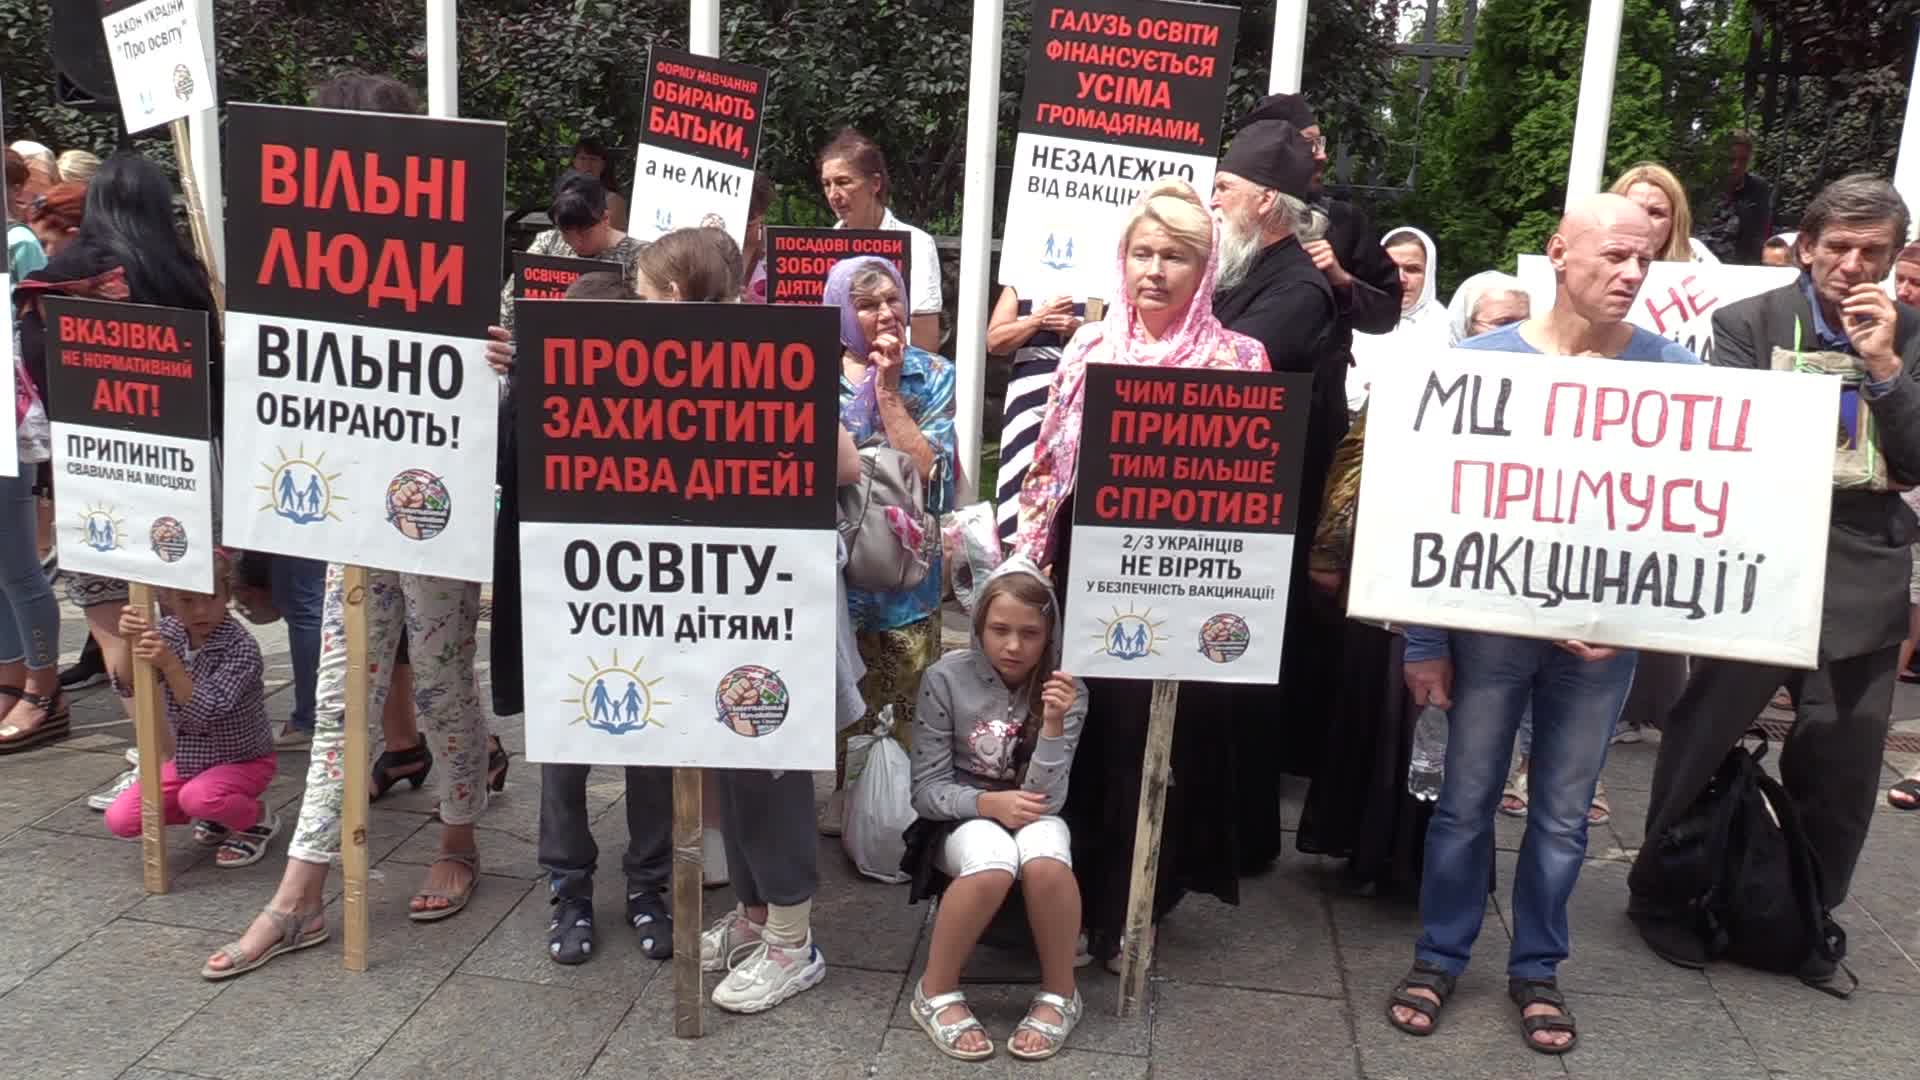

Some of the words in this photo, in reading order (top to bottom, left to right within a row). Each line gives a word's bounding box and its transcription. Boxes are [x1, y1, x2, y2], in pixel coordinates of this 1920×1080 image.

[1051, 8, 1131, 37] ГАЛУЗЬ
[1137, 19, 1219, 46] ОСВІТИ
[1046, 40, 1215, 77] ФІНАНСУЄТЬСЯ
[656, 62, 696, 80] ФОРМУ
[697, 71, 758, 94] НАВЧАННЯ
[1076, 72, 1173, 109] УСІМА
[653, 80, 755, 120] ОБИРАЮТЬ
[649, 106, 749, 159] БАТЬКИ,
[1036, 104, 1205, 145] ГРОМАДЯНАМИ,
[260, 143, 465, 222] ВІЛЬНІ
[646, 160, 657, 176] а
[663, 164, 686, 183] не
[691, 166, 741, 197] ЛКК!
[1031, 145, 1194, 182] НЕЗАЛЕЖНО
[1028, 176, 1059, 198] ВІД
[775, 237, 849, 253] ПОСАДОВІ
[852, 239, 902, 253] ОСОБИ
[257, 227, 464, 312] ЛЮДИ
[775, 280, 823, 297] ДІЯТИ
[1645, 275, 1718, 335] НЕ
[58, 315, 179, 352] ВКАЗІВКА
[62, 350, 81, 366] НЕ
[83, 353, 193, 378] НОРМАТИВНИЙ
[258, 324, 463, 400] ВІЛЬНО
[543, 338, 816, 391] ПРОСИМО
[92, 378, 161, 417] АКТ!
[1115, 378, 1175, 406] ЧИМ
[1182, 384, 1285, 411] БІЛЬШЕ
[257, 392, 460, 449] ОБИРАЮТЬ!
[543, 396, 815, 444] ЗАХИСТИТИ
[1109, 410, 1280, 456] ПРИМУС,
[66, 434, 194, 473] ПРИПИНІТЬ
[1109, 453, 1165, 478] ТИМ
[1173, 457, 1276, 484] БІЛЬШЕ
[66, 462, 124, 481] СВАВІЛЛЯ
[127, 469, 143, 484] НА
[145, 473, 197, 491] МІСЦЯХ!
[544, 455, 677, 493] ПРАВА
[685, 451, 815, 501] ДІТЕЙ!
[1095, 485, 1284, 526] СПРОТИВ!
[1122, 534, 1154, 551] 2/3
[1158, 535, 1243, 554] УКРАЇНЦІВ
[563, 539, 793, 595] ОСВІТУ-
[1120, 555, 1152, 577] НЕ
[1159, 556, 1242, 579] ВІРЯТЬ
[1086, 581, 1095, 592] У
[1097, 582, 1185, 596] БЕЗПЕЧНІСТЬ
[1189, 585, 1275, 600] ВАКЦИНАЦІЇ!
[568, 602, 663, 637] УСІМ
[674, 606, 793, 643] дітям!
